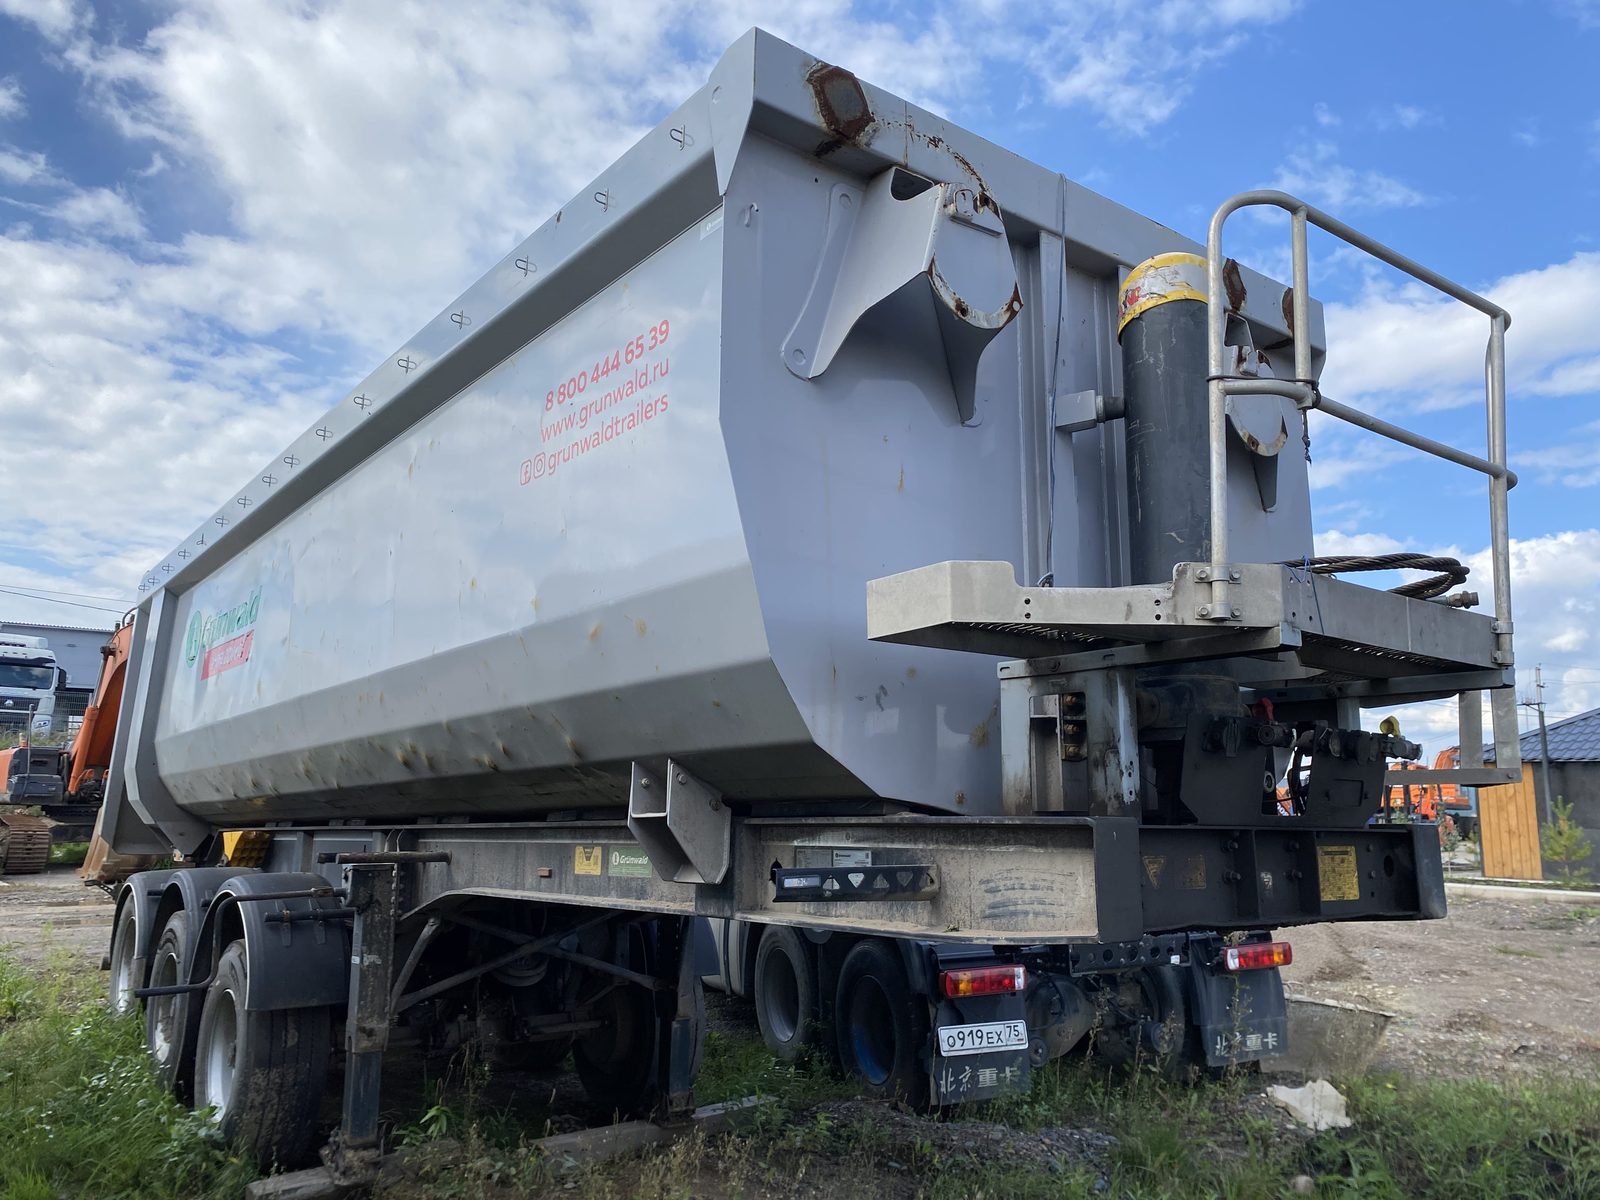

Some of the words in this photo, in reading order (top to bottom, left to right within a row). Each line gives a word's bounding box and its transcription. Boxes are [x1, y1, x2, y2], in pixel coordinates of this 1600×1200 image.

[540, 357, 669, 443] www.grunwald.ru
[544, 390, 555, 412] 8
[556, 371, 588, 405] 800
[590, 350, 621, 384] 444
[624, 334, 645, 365] 65
[648, 319, 670, 351] 39
[547, 394, 669, 476] grunwaldtrailers
[1006, 1025, 1020, 1038] 75
